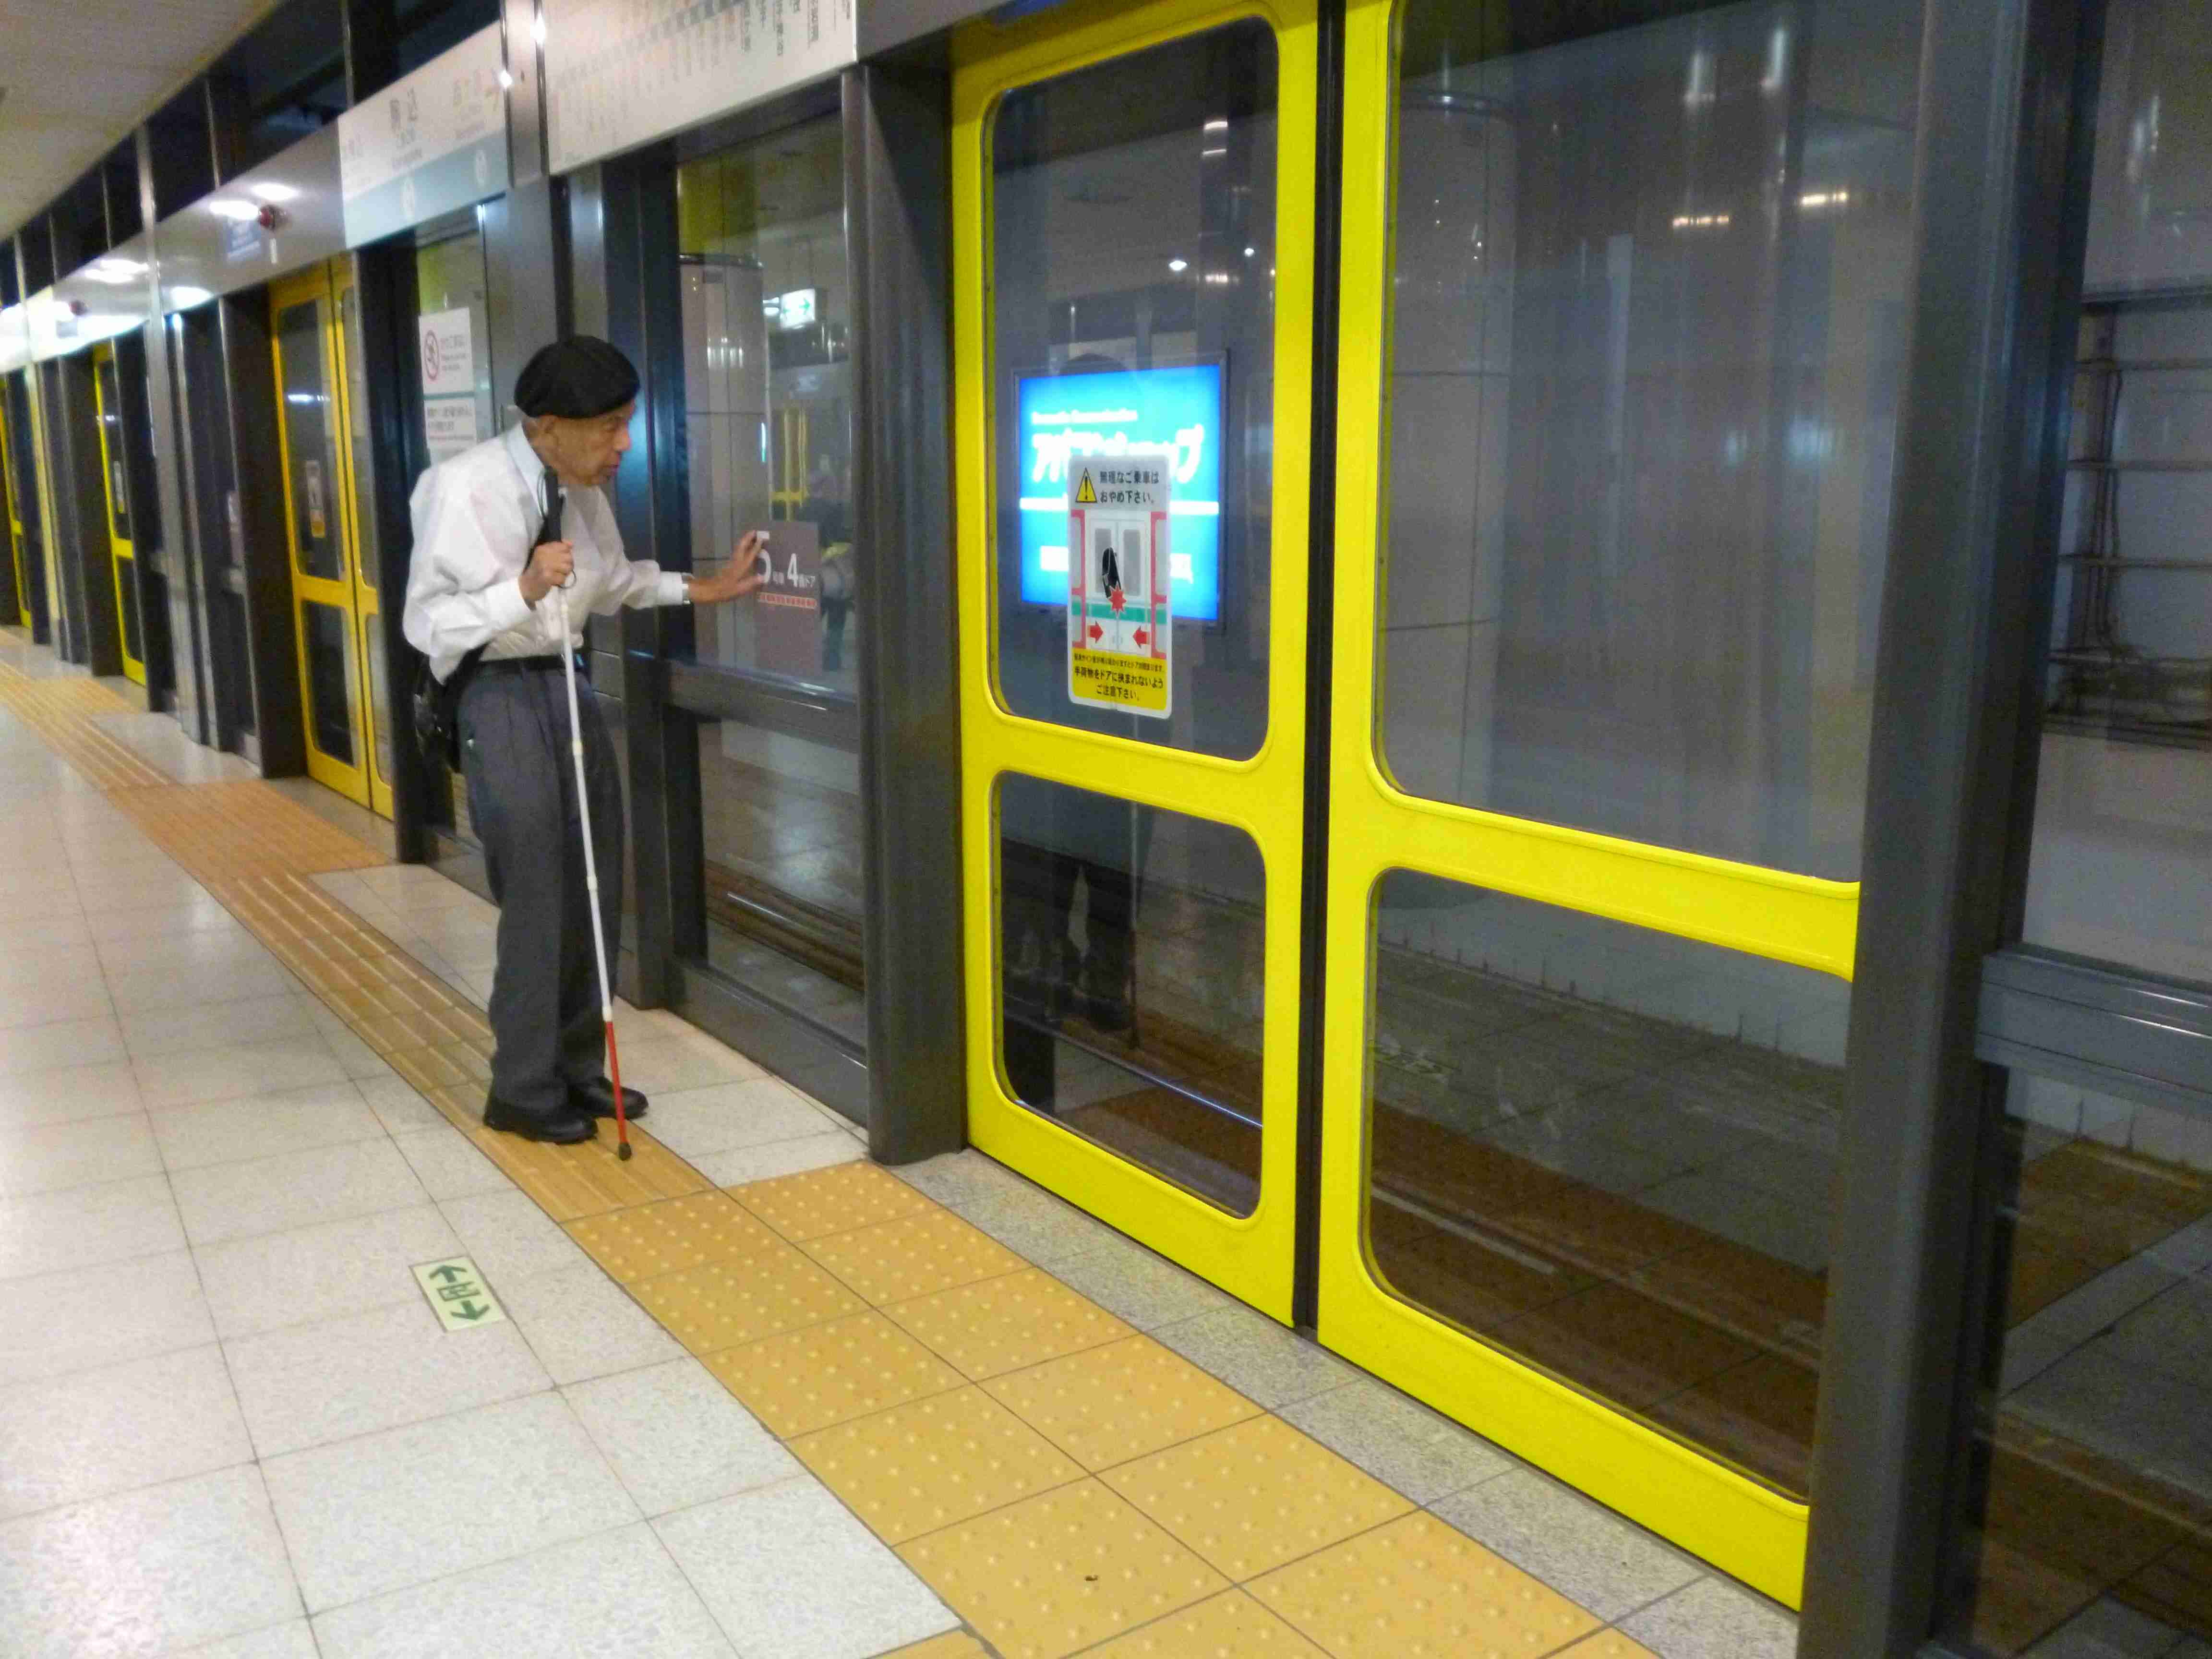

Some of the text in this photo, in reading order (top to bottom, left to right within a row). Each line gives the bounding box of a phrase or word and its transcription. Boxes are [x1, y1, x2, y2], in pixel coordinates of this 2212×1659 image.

[1100, 490, 1154, 505] おやめ下さい。
